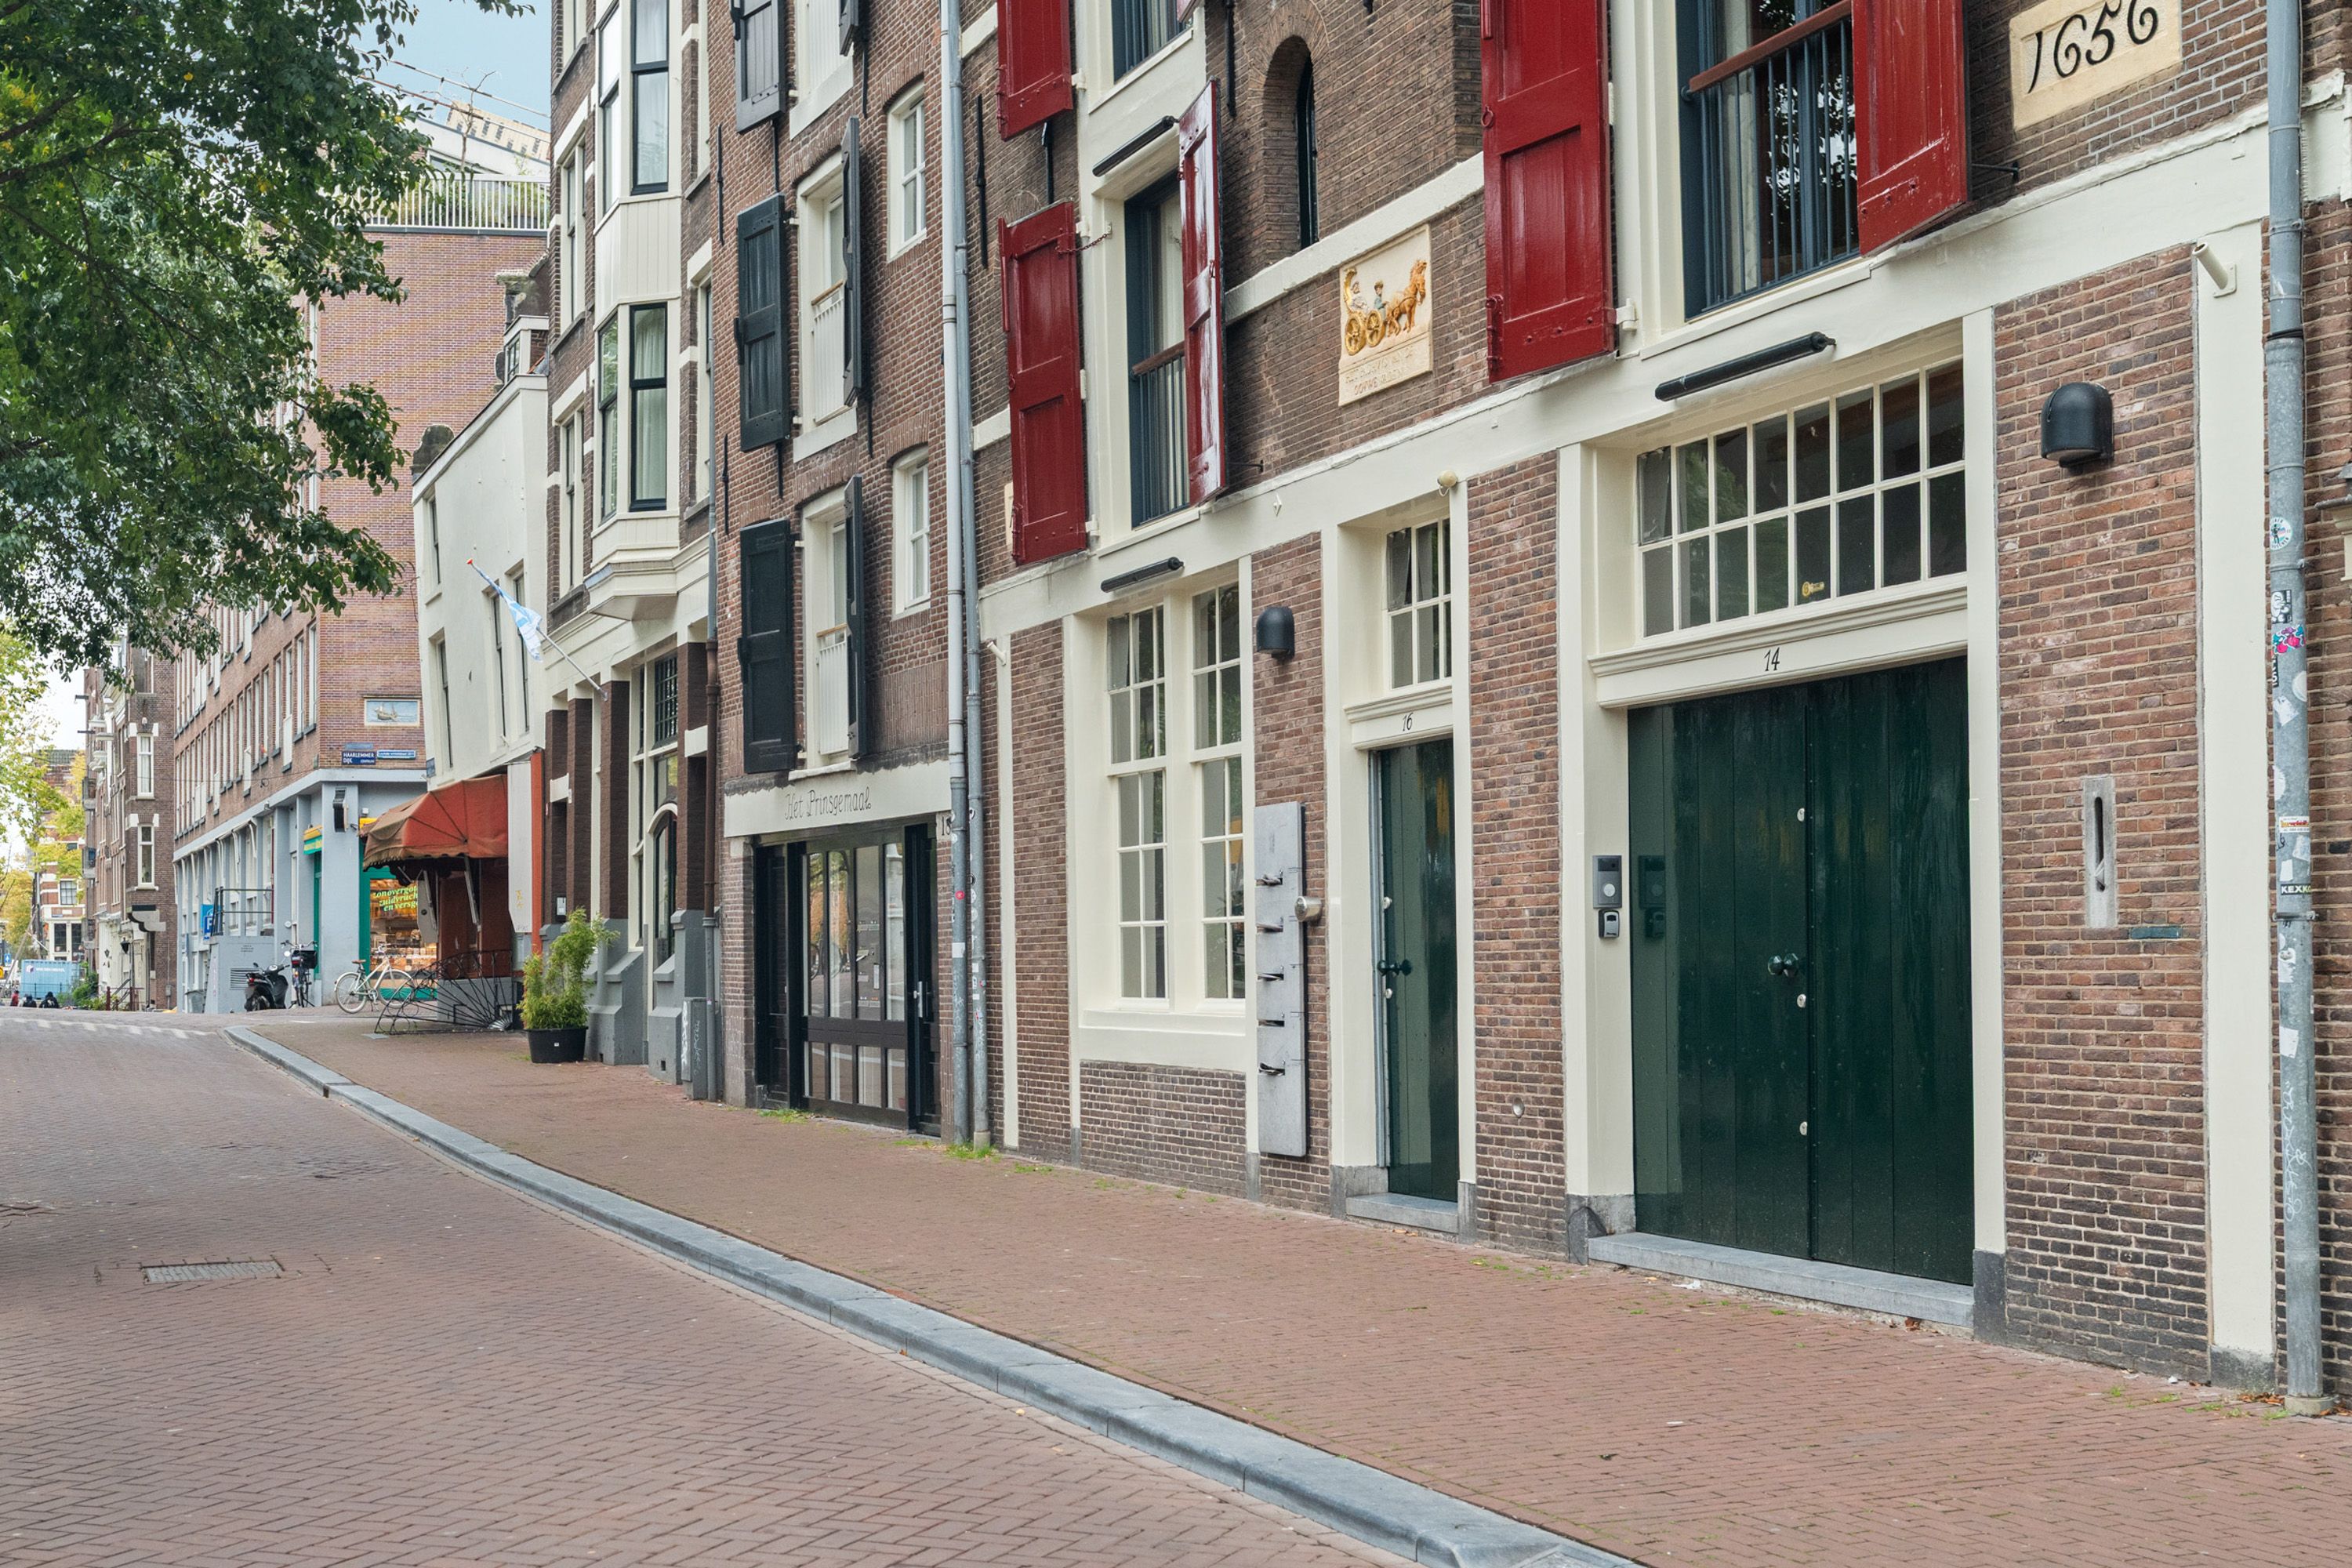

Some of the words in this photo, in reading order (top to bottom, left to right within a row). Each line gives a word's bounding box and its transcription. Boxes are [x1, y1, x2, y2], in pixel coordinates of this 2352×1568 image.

[2027, 0, 2159, 94] 1656
[1763, 647, 1780, 671] 14
[1403, 712, 1414, 731] 16
[785, 793, 804, 820] Het
[806, 786, 872, 817] Prinsgemaal
